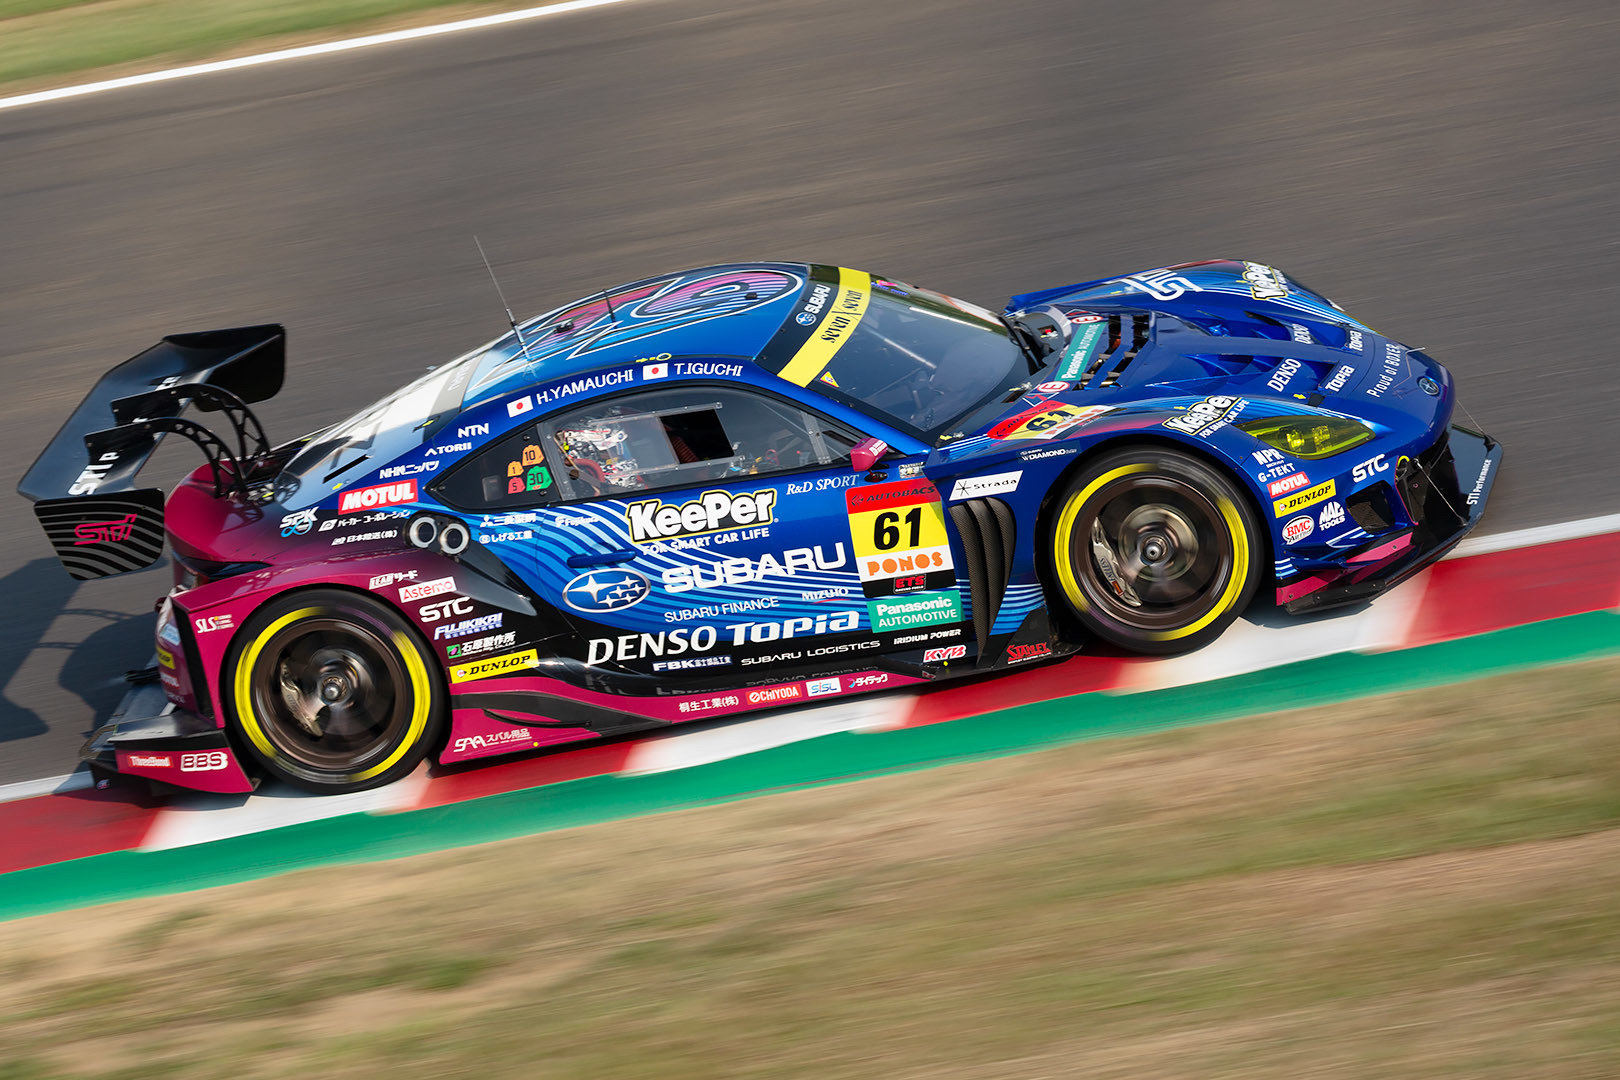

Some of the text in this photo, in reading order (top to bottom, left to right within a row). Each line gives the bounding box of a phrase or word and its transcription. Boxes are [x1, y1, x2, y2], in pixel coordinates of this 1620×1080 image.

[804, 284, 831, 314] SUBARU
[674, 363, 743, 377] T.IGUCHI
[1061, 349, 1087, 379] Panasonic
[1267, 358, 1301, 392] DENSO
[536, 369, 634, 405] H.YAMAUCHI
[1366, 374, 1393, 398] Proud
[1234, 399, 1251, 414] LIFE
[457, 423, 490, 438] NTN
[1026, 410, 1075, 432] 61
[524, 450, 536, 461] 10
[1251, 448, 1285, 466] NPR
[529, 472, 544, 485] 30
[1258, 463, 1296, 483] G-TEKT
[1352, 453, 1389, 483] STC
[1472, 459, 1492, 493] Performance
[69, 463, 114, 496] STI
[786, 474, 860, 496] R&D SPORT
[973, 478, 1017, 490] Strada
[1270, 473, 1309, 497] MOTUL
[341, 482, 415, 511] MOTUL
[866, 485, 936, 503] AUTOBACS
[1288, 485, 1331, 509] DUNLOP
[280, 506, 319, 527] SPK
[626, 489, 776, 542] KeePer
[1319, 501, 1345, 525] MAC
[1319, 513, 1346, 531] TOOLS
[873, 507, 922, 551] 61
[1287, 518, 1312, 539] BMC
[642, 528, 770, 556] FOR SMART CAR LIFE
[661, 542, 847, 594] SUBARU
[867, 551, 944, 577] PONOS
[403, 580, 454, 600] Astemo
[895, 575, 925, 589] ETS
[801, 587, 849, 601] MIZUHO
[419, 596, 474, 623] STC
[664, 596, 780, 623] SUBARU FINANCE
[876, 597, 953, 617] Panasonic
[195, 616, 217, 634] SLS
[878, 609, 958, 628] AUTOMOTIVE
[586, 625, 717, 668] DENSO
[893, 629, 962, 645] IRIDIUM POWER
[741, 640, 881, 666] SUBARU LOGISTICS
[923, 644, 966, 663] KYB
[1006, 642, 1052, 662] STANLEY
[469, 655, 531, 676] DUNLOP
[652, 659, 695, 672] FBK
[679, 696, 739, 713] 桐生工業(株)
[486, 728, 530, 744] スバル用品
[182, 752, 227, 772] BBS
